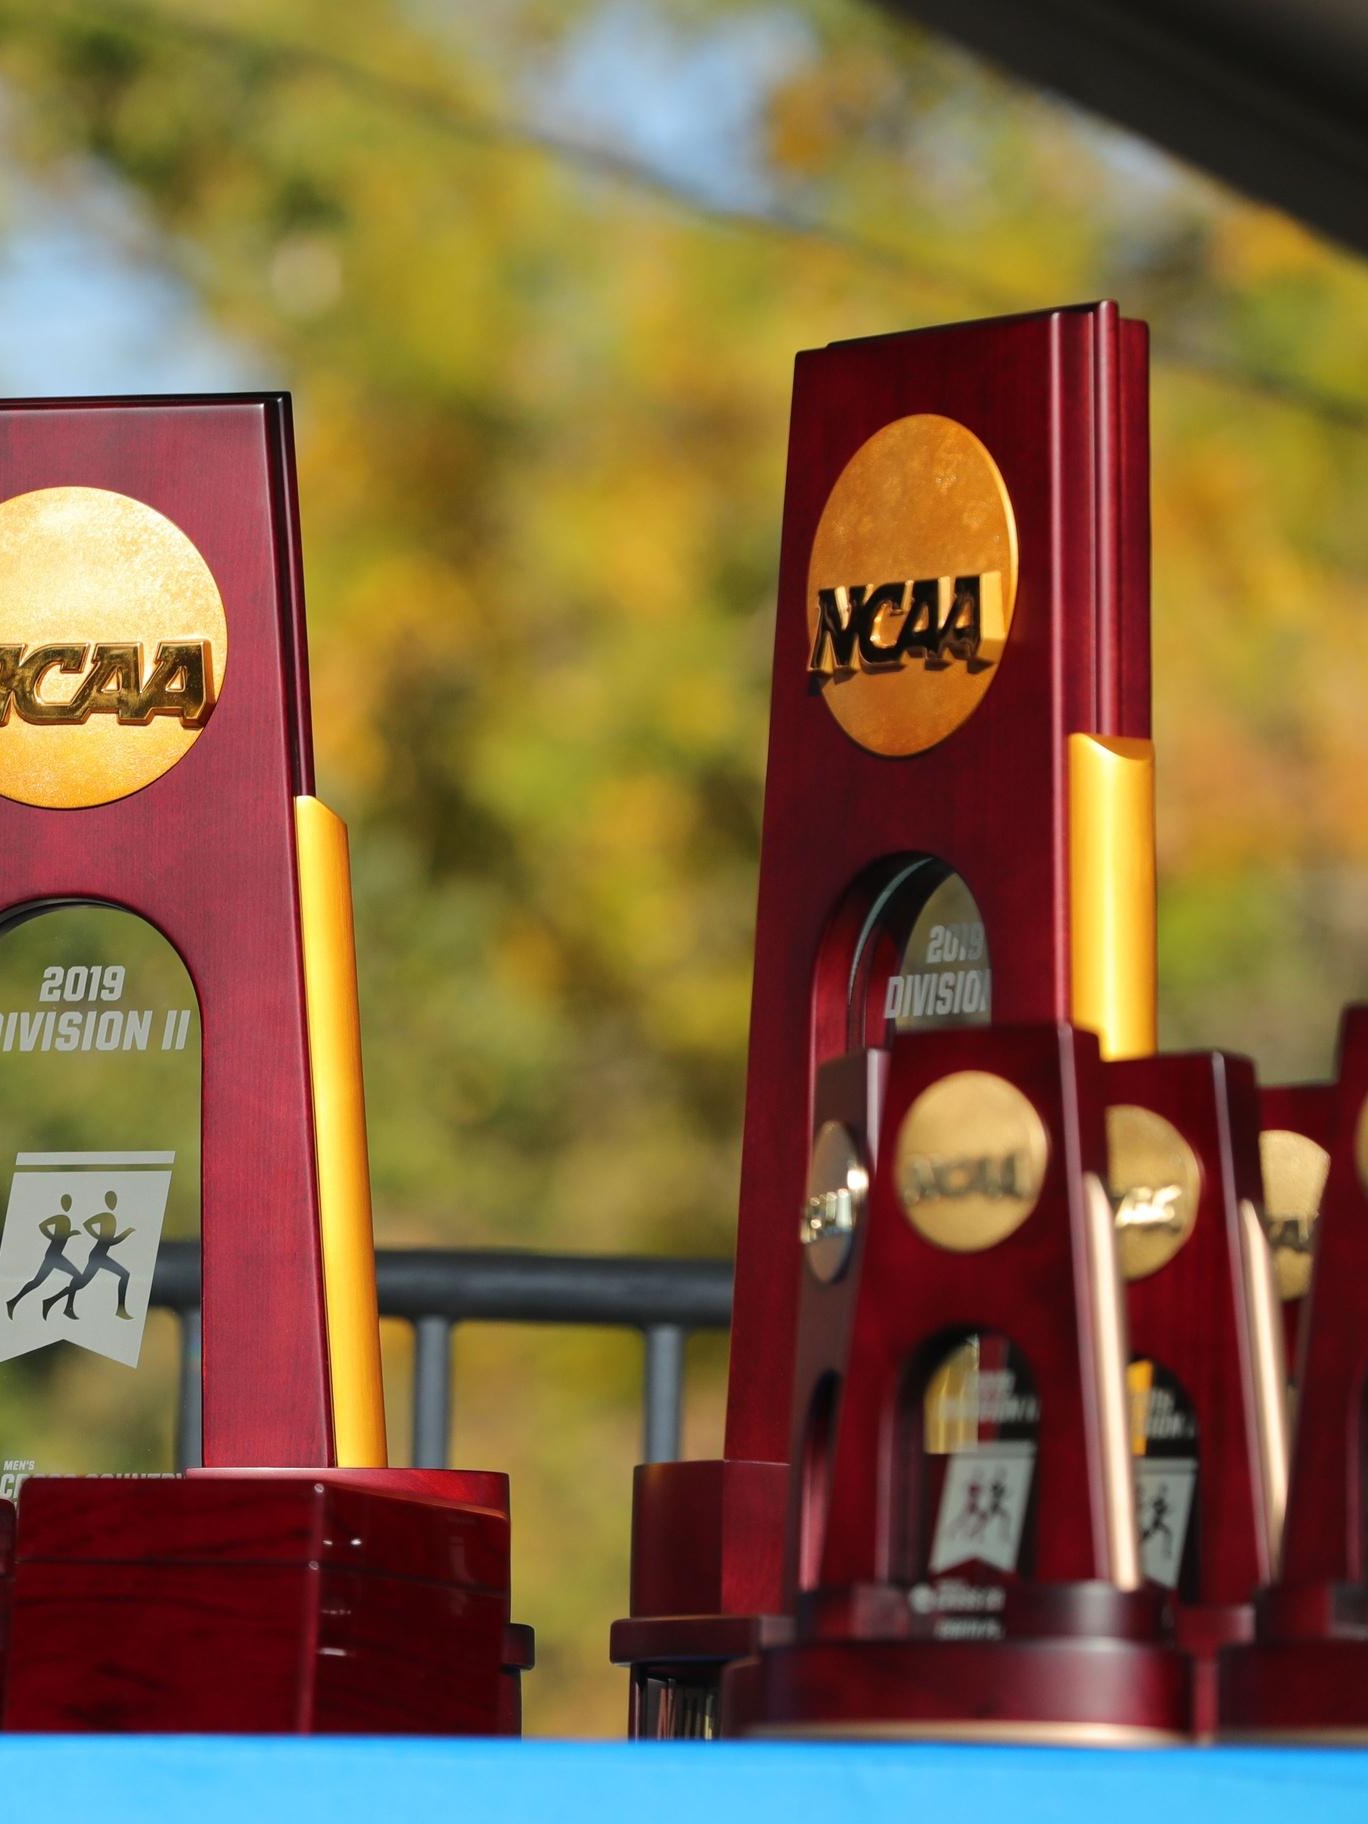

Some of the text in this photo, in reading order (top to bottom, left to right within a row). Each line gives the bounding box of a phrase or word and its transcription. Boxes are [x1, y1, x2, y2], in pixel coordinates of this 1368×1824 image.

[807, 572, 998, 674] NCAA
[39, 965, 126, 1002] 2019
[161, 1009, 191, 1051] II
[3, 1459, 36, 1472] MEN'S
